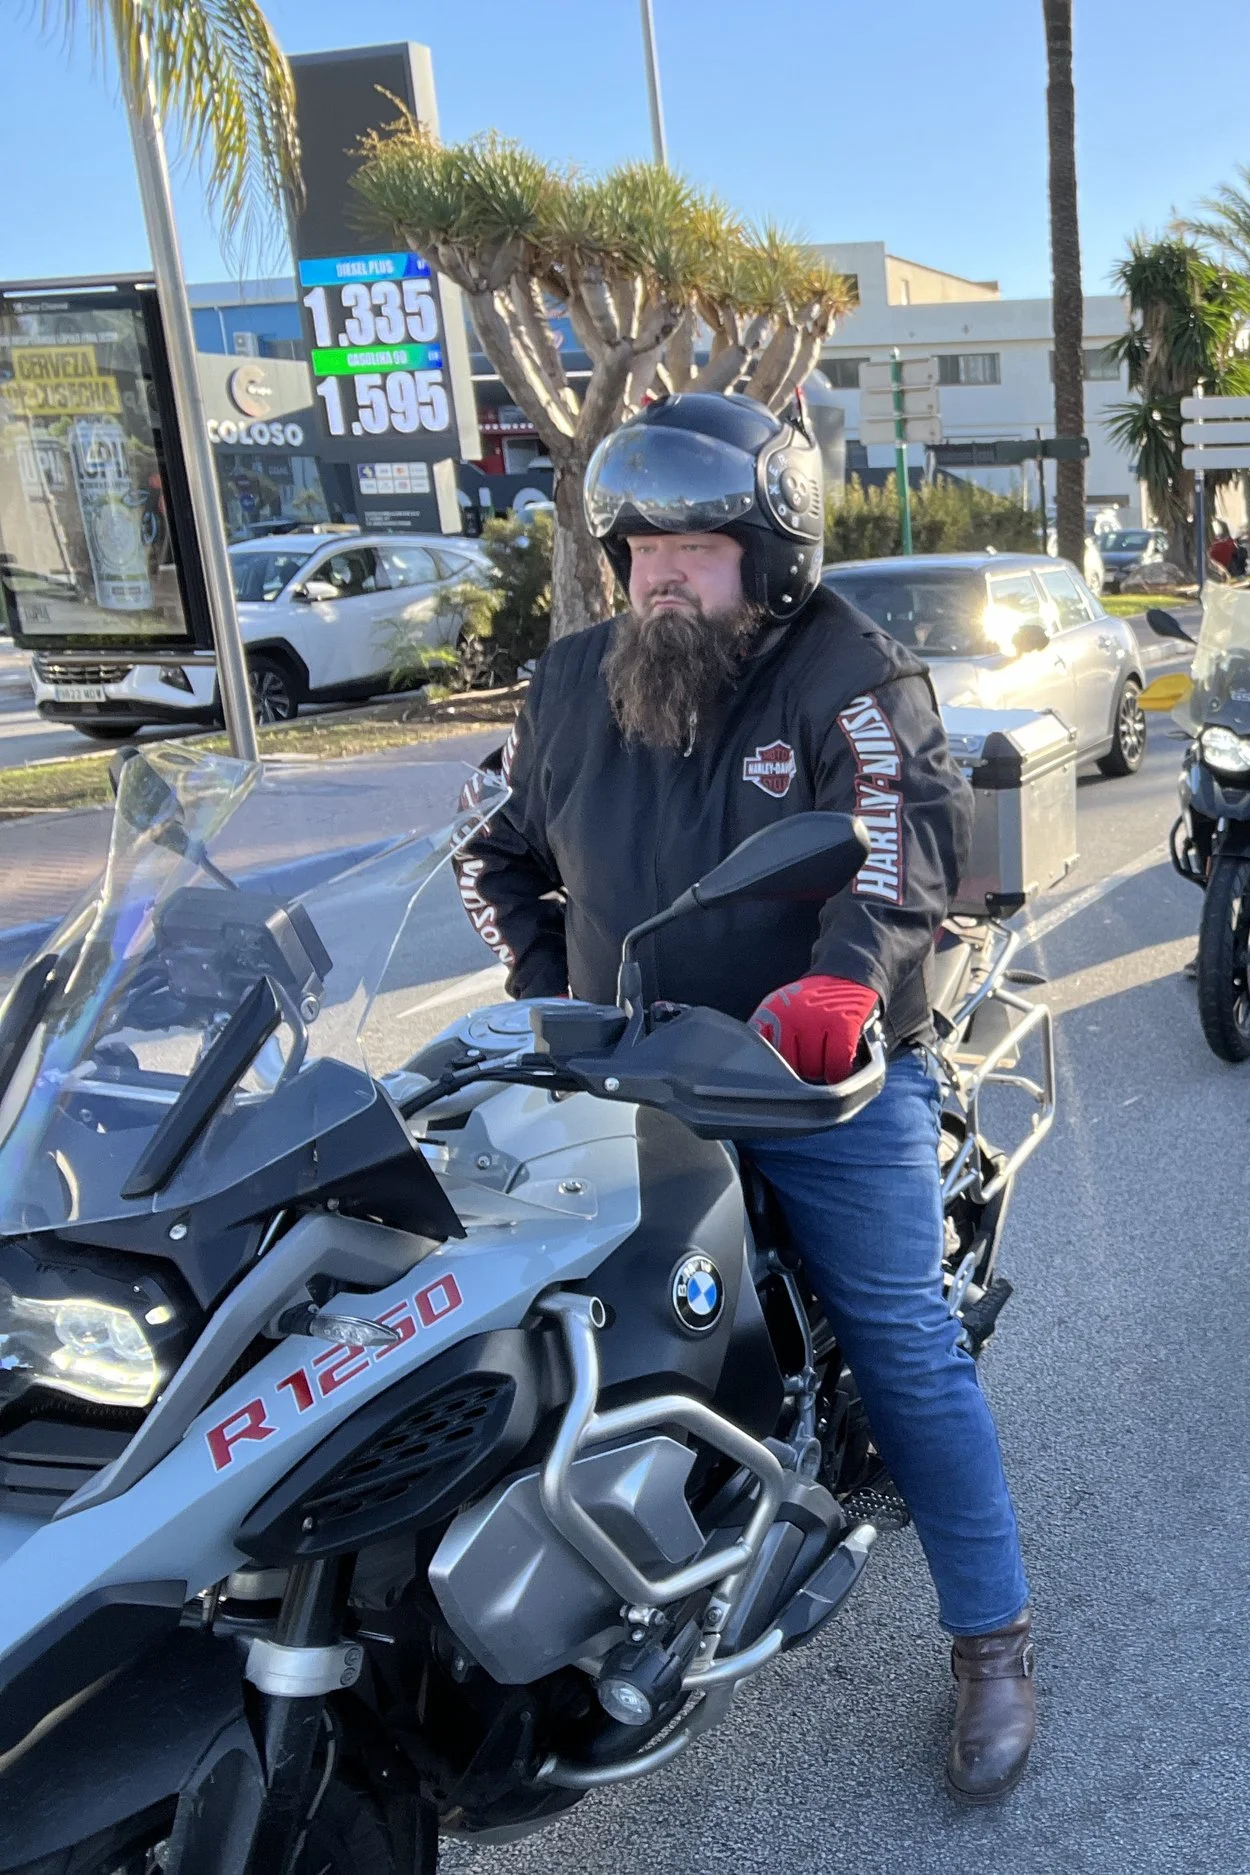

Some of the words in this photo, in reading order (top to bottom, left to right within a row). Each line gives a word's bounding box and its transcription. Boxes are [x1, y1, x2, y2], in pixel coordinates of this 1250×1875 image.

[336, 262, 368, 278] DIESEL
[368, 259, 394, 275] PLUS
[303, 278, 439, 347] 1.335
[316, 369, 450, 436] 1.595
[207, 419, 304, 447] COLOSO
[761, 748, 790, 761] MOTO
[677, 1260, 713, 1297] BMW
[204, 1396, 277, 1472] R
[275, 1272, 465, 1415] 1250
